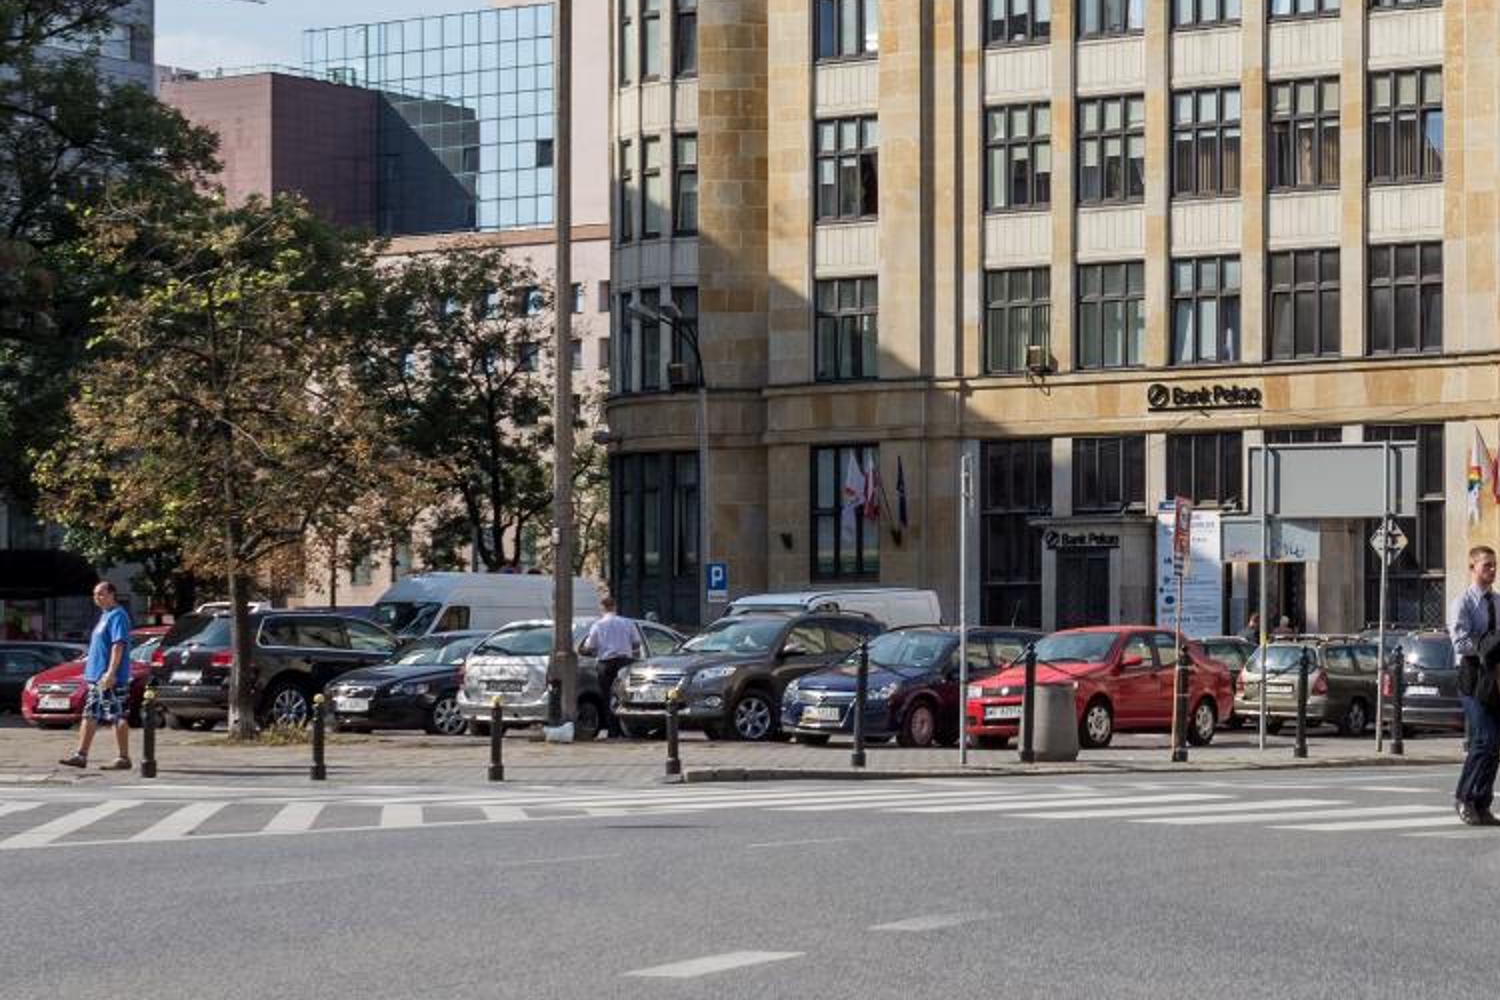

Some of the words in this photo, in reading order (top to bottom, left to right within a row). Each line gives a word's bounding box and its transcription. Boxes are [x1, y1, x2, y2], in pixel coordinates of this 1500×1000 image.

[1173, 386, 1212, 405] Bank
[1213, 384, 1262, 402] Pekao
[711, 566, 723, 588] P
